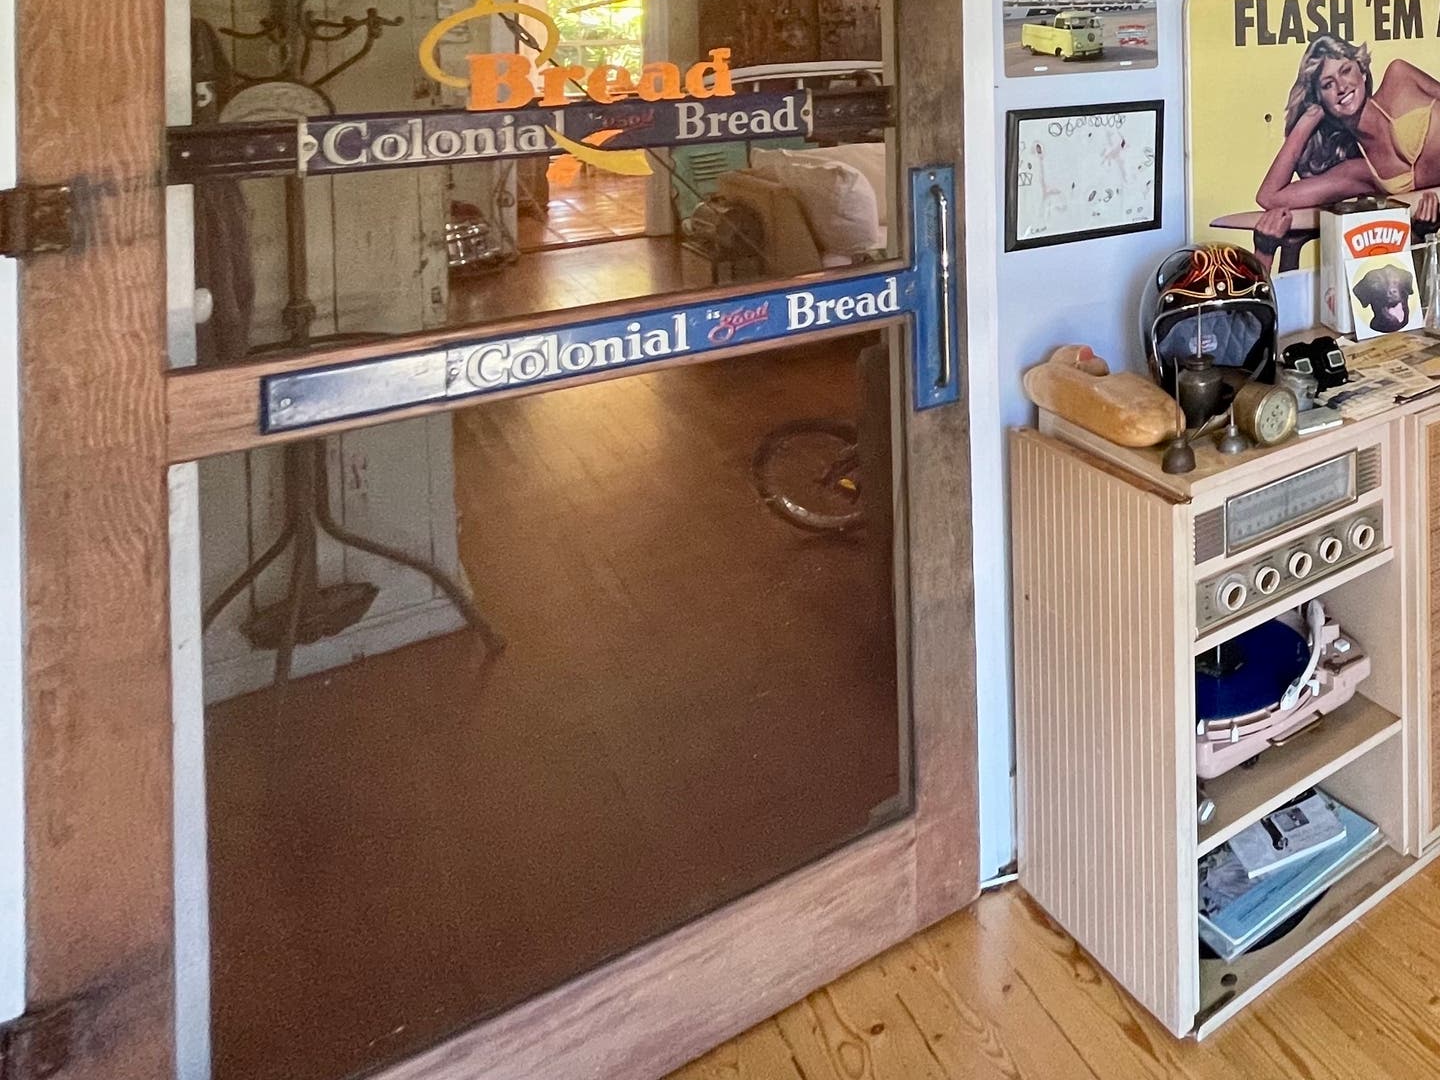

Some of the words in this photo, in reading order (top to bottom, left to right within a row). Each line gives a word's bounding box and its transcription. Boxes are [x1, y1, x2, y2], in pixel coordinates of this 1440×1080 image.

[466, 47, 735, 112] Bread
[322, 110, 565, 167] Colonial
[674, 96, 799, 140] Bread
[1351, 226, 1405, 252] OILZUM
[705, 308, 721, 321] is
[707, 300, 769, 345] good
[785, 277, 900, 331] Bread
[465, 313, 690, 389] Colonial
